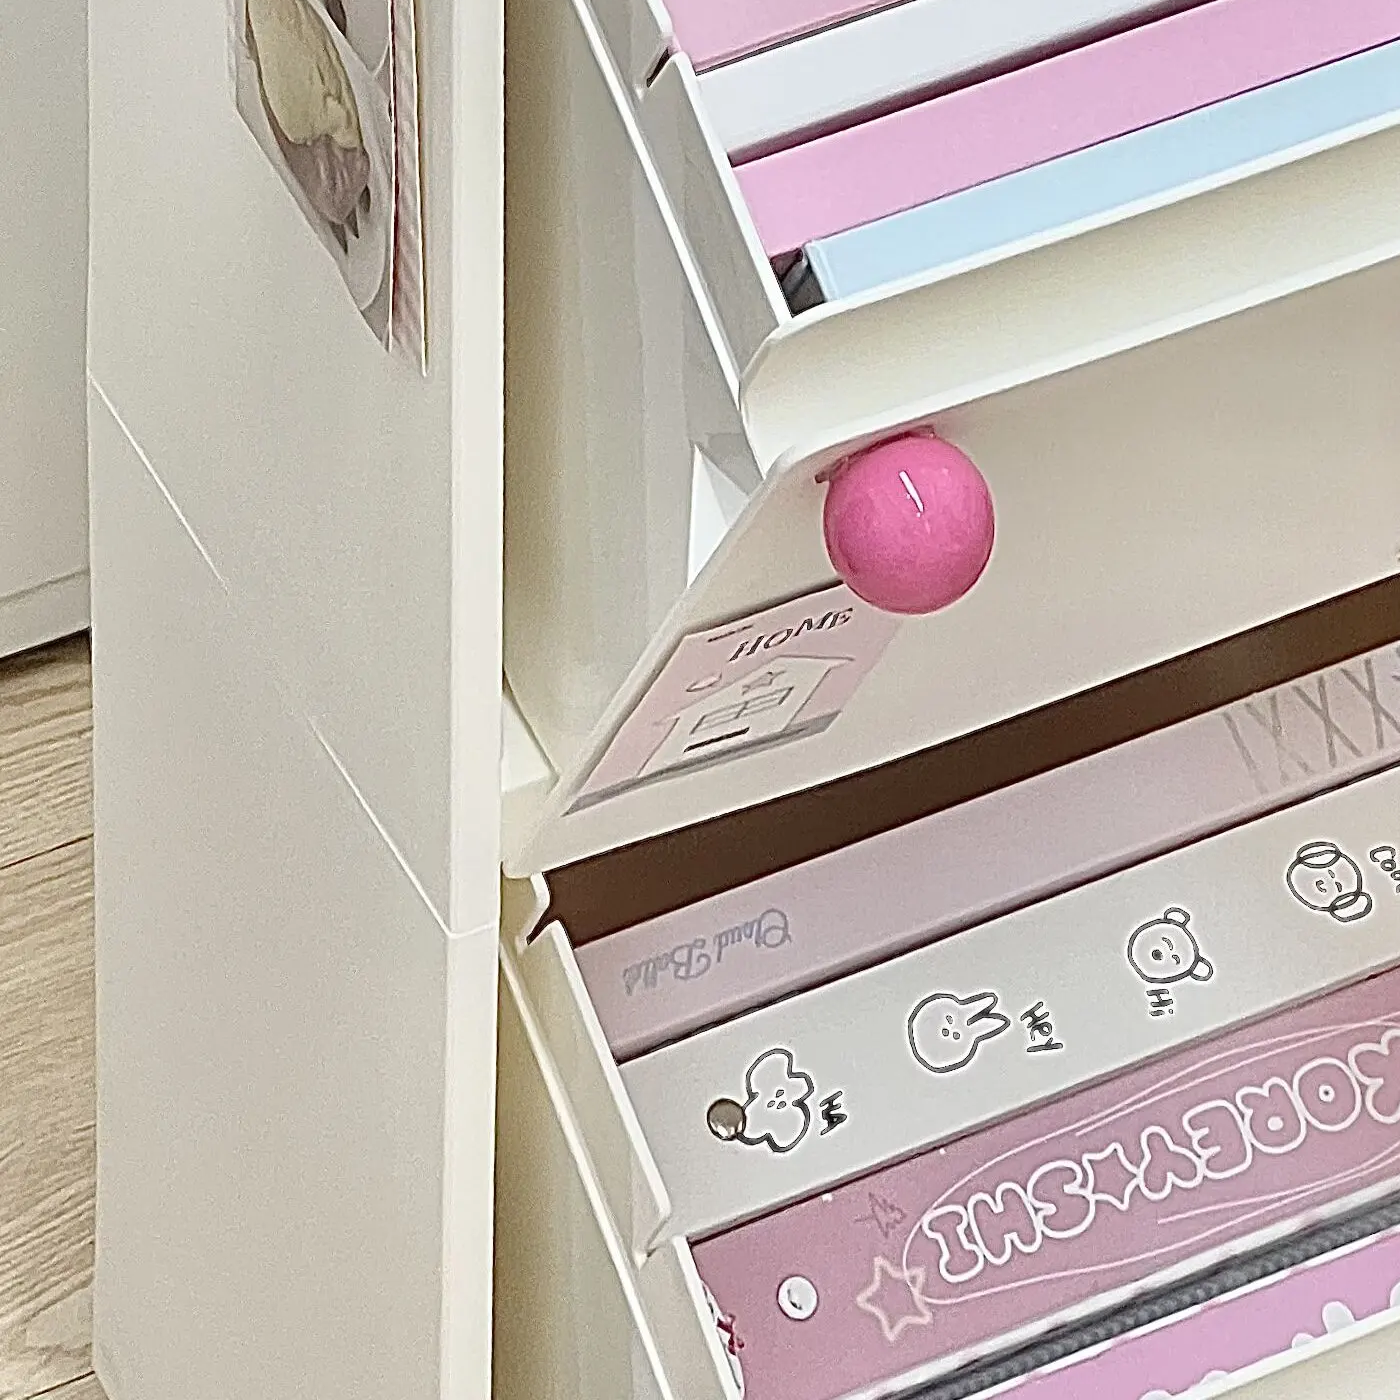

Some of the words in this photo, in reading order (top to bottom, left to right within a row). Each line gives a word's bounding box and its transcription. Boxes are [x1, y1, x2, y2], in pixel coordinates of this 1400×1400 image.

[728, 606, 854, 663] HOME
[714, 907, 793, 964] Cloud
[1146, 987, 1175, 1018] Hi
